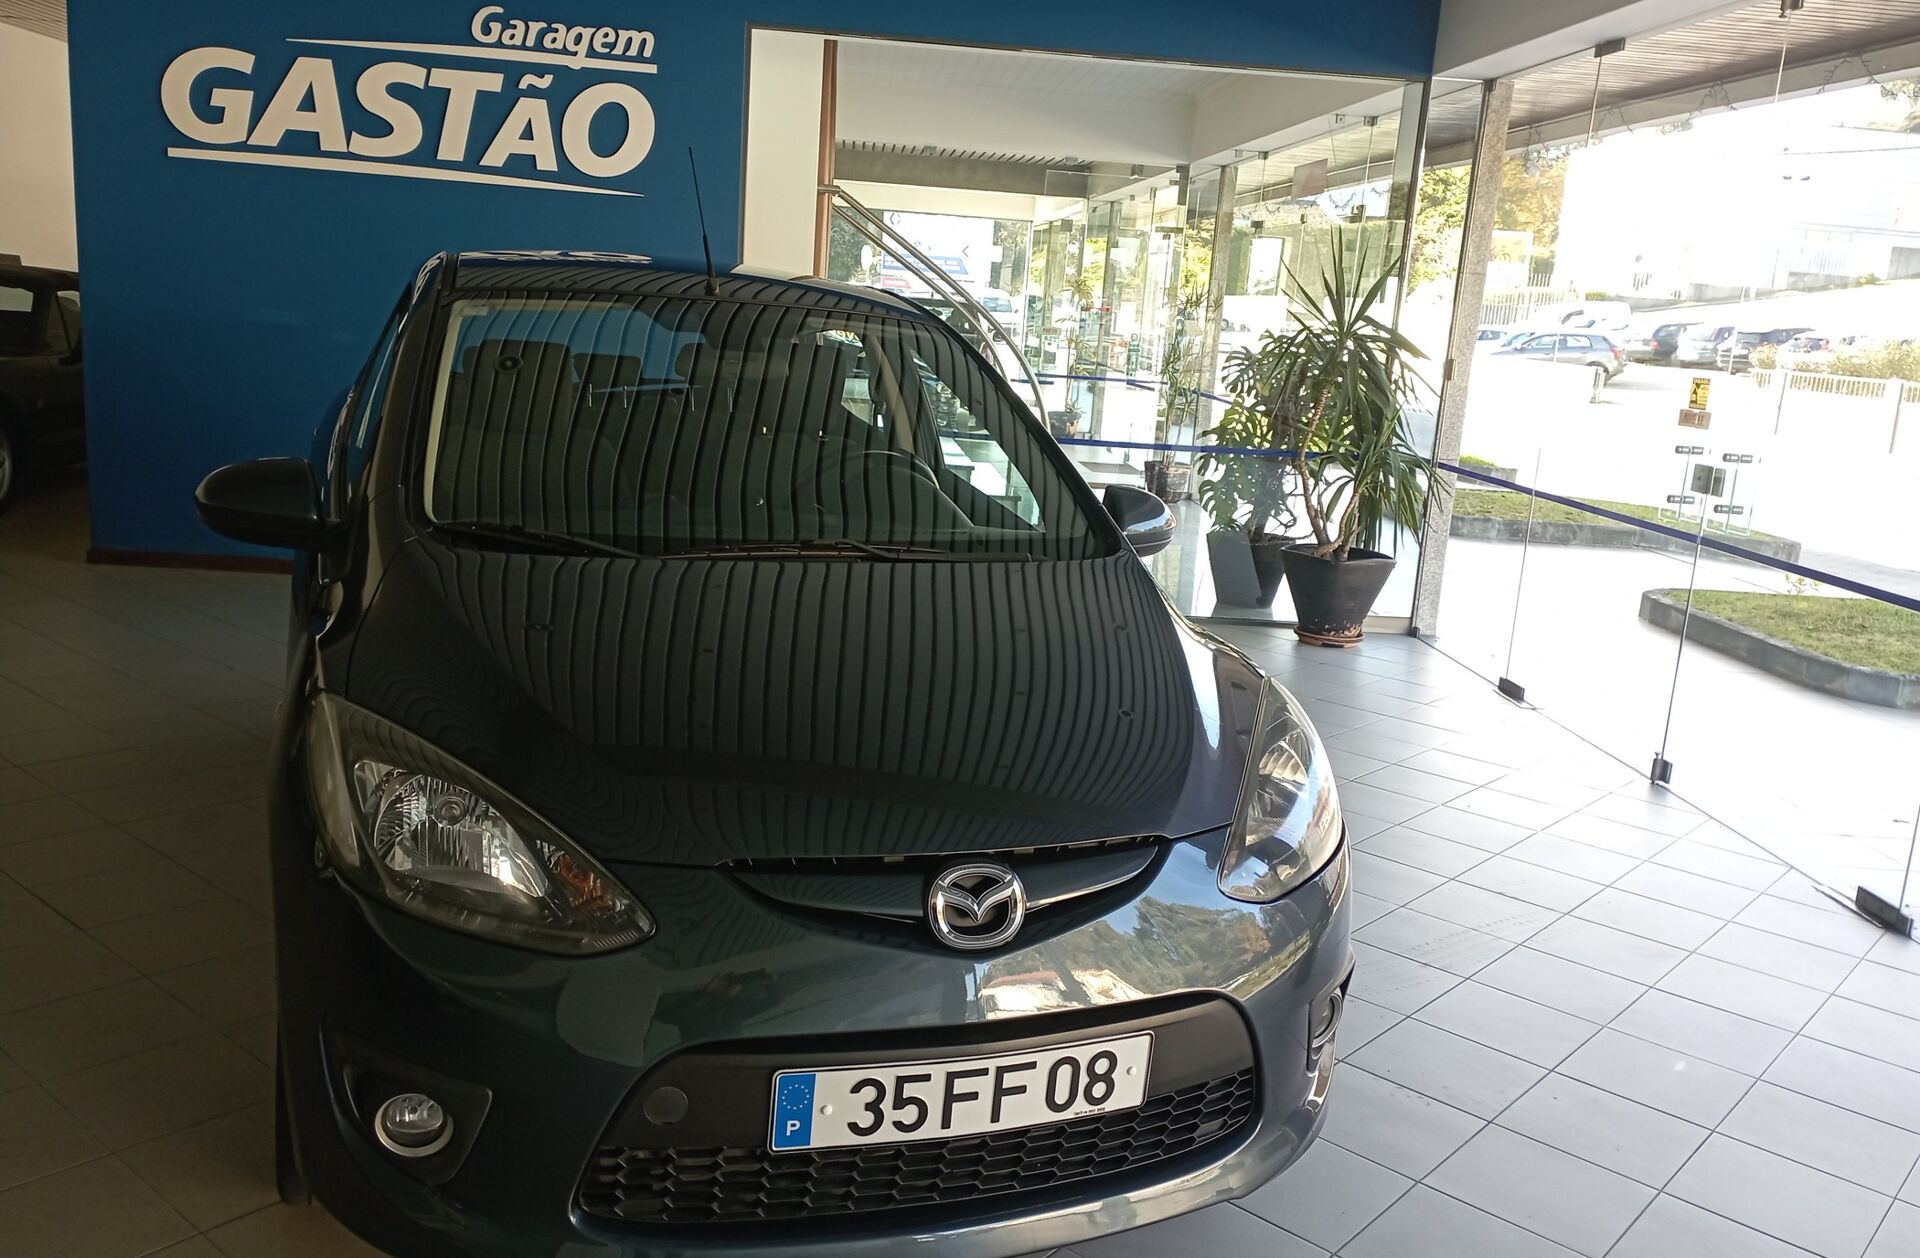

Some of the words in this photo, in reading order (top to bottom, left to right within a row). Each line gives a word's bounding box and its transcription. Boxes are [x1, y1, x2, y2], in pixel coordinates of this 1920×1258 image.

[471, 5, 656, 67] Garagem
[160, 46, 656, 178] GASTÃO
[785, 1120, 801, 1137] P
